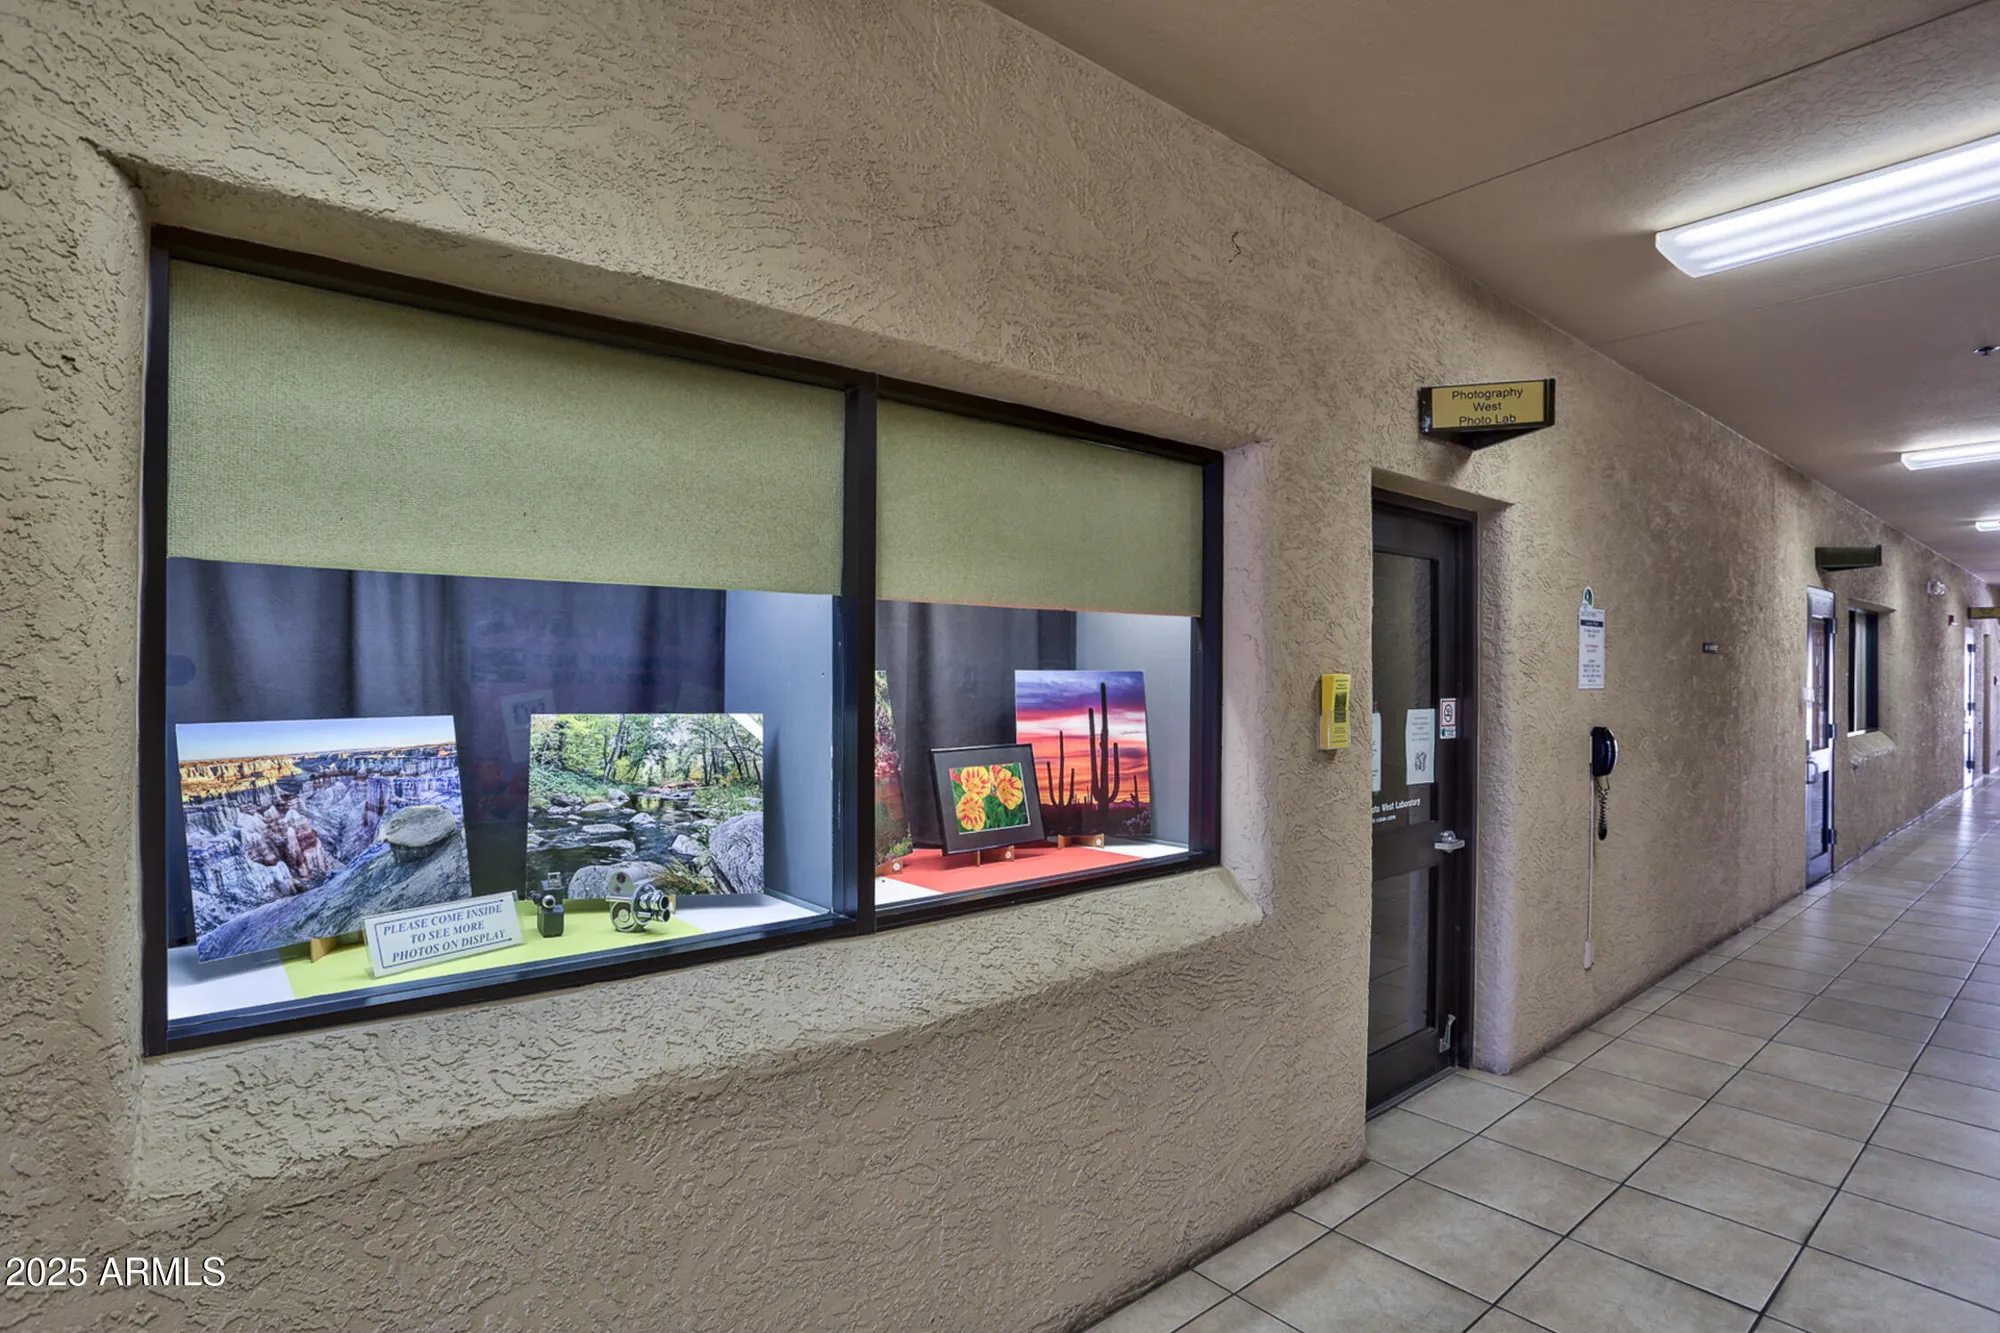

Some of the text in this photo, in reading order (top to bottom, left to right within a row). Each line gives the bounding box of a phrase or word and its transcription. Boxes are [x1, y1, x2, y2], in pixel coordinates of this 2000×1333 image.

[1452, 388, 1524, 400] Photography
[1473, 402, 1502, 412] West
[1459, 414, 1517, 425] Photo Lab
[383, 904, 503, 936] PLEASE COME INSIDE
[411, 921, 485, 944] TO SEE MORE
[392, 929, 506, 963] PHOTOS ON DISPLAY
